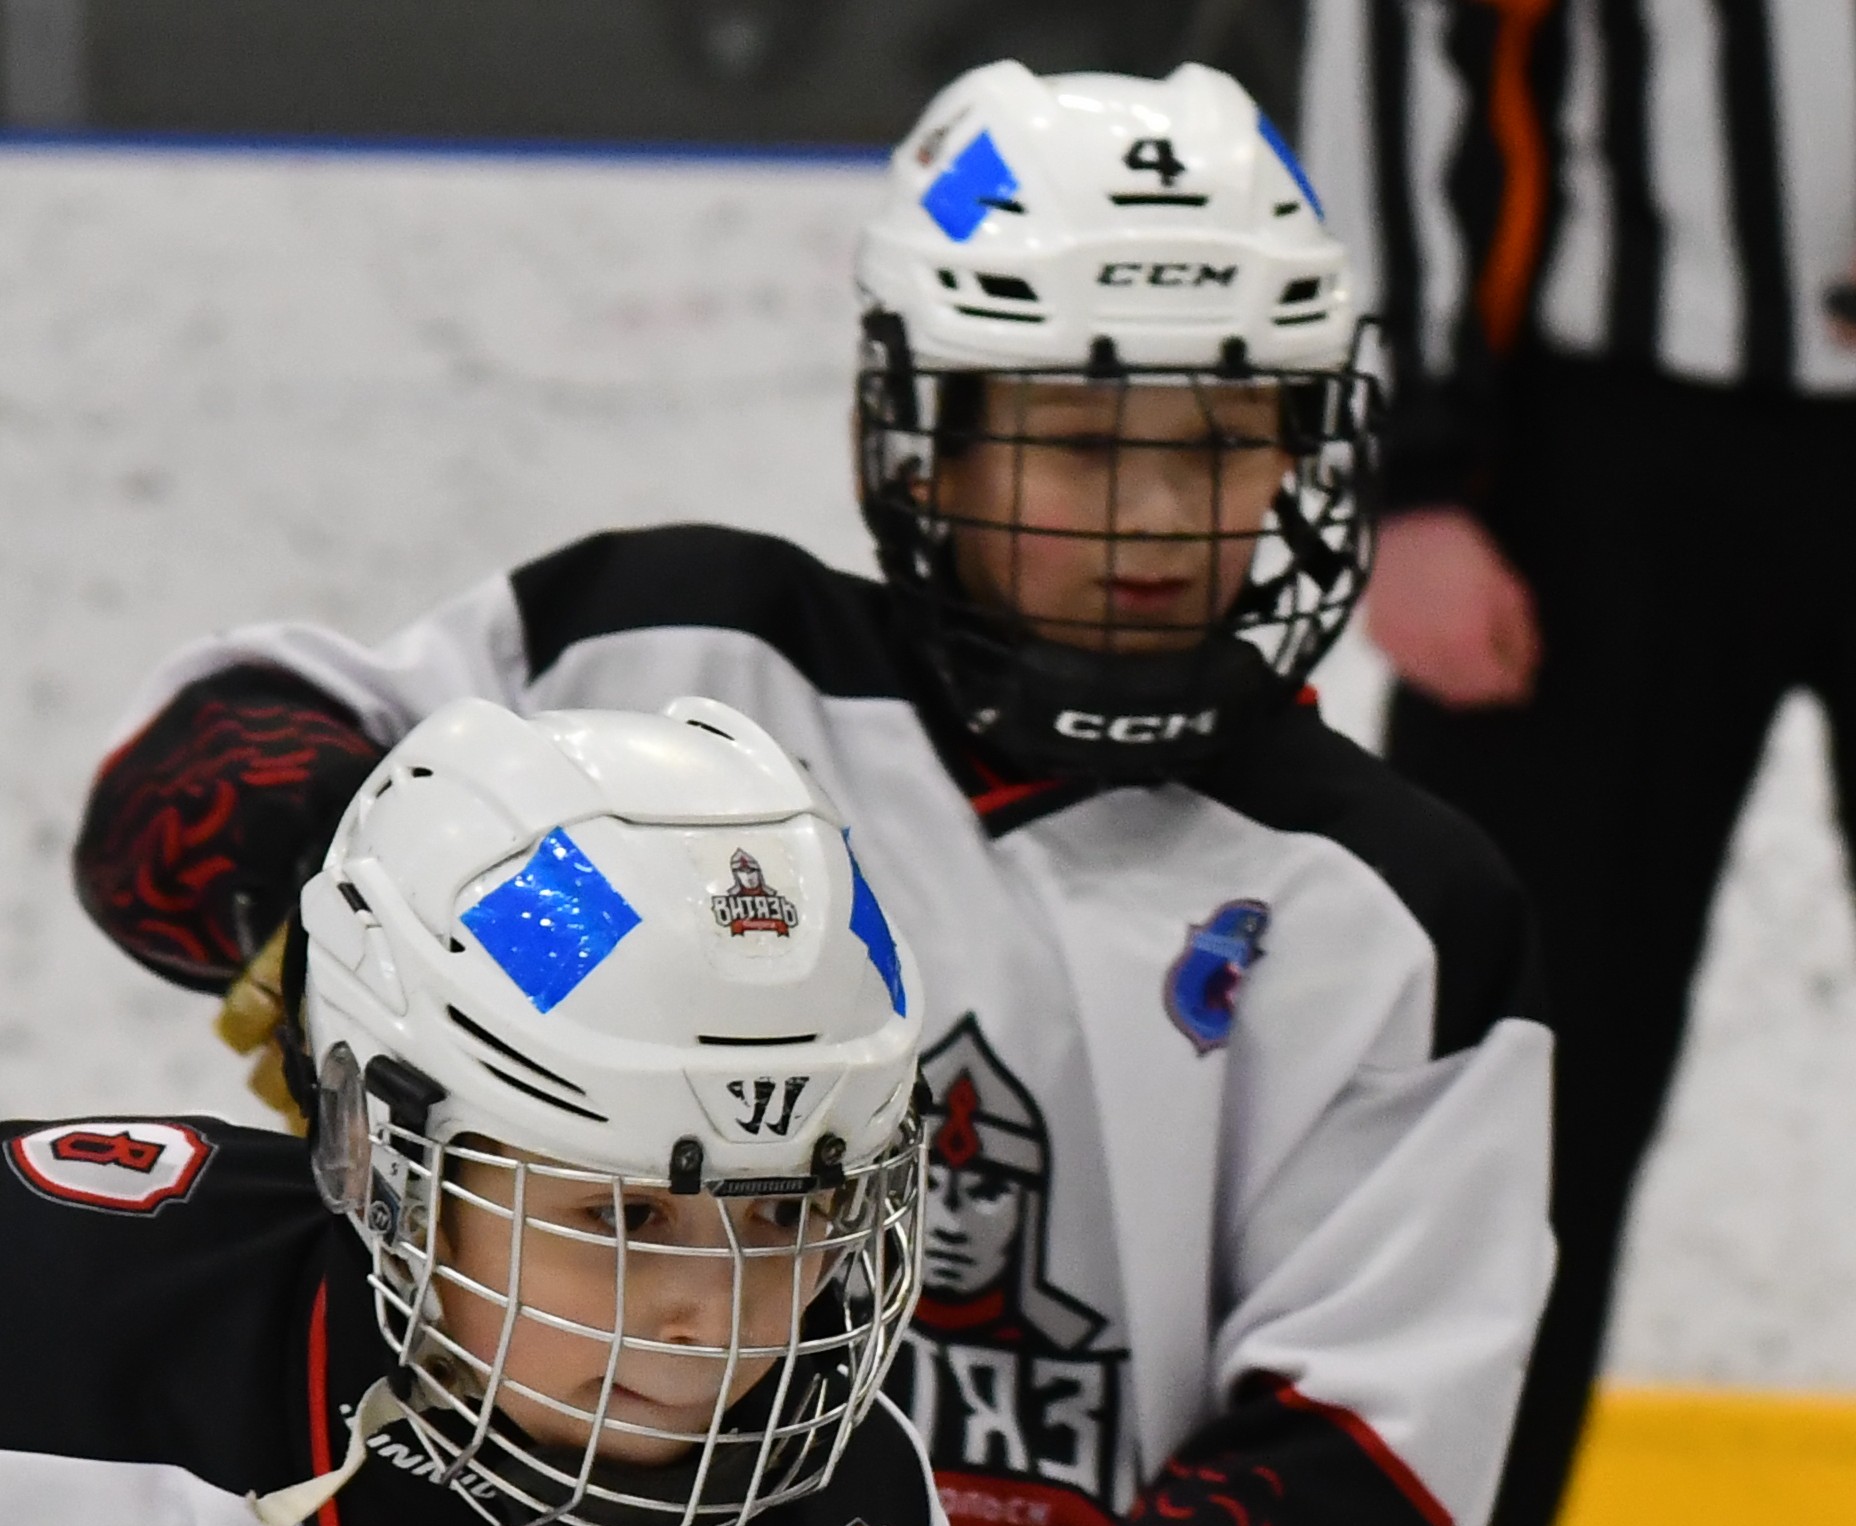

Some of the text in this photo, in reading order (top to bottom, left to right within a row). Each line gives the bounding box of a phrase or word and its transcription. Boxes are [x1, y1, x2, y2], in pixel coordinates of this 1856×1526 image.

[1122, 137, 1186, 187] 4
[1096, 262, 1238, 289] CCM
[1053, 708, 1217, 743] CCM
